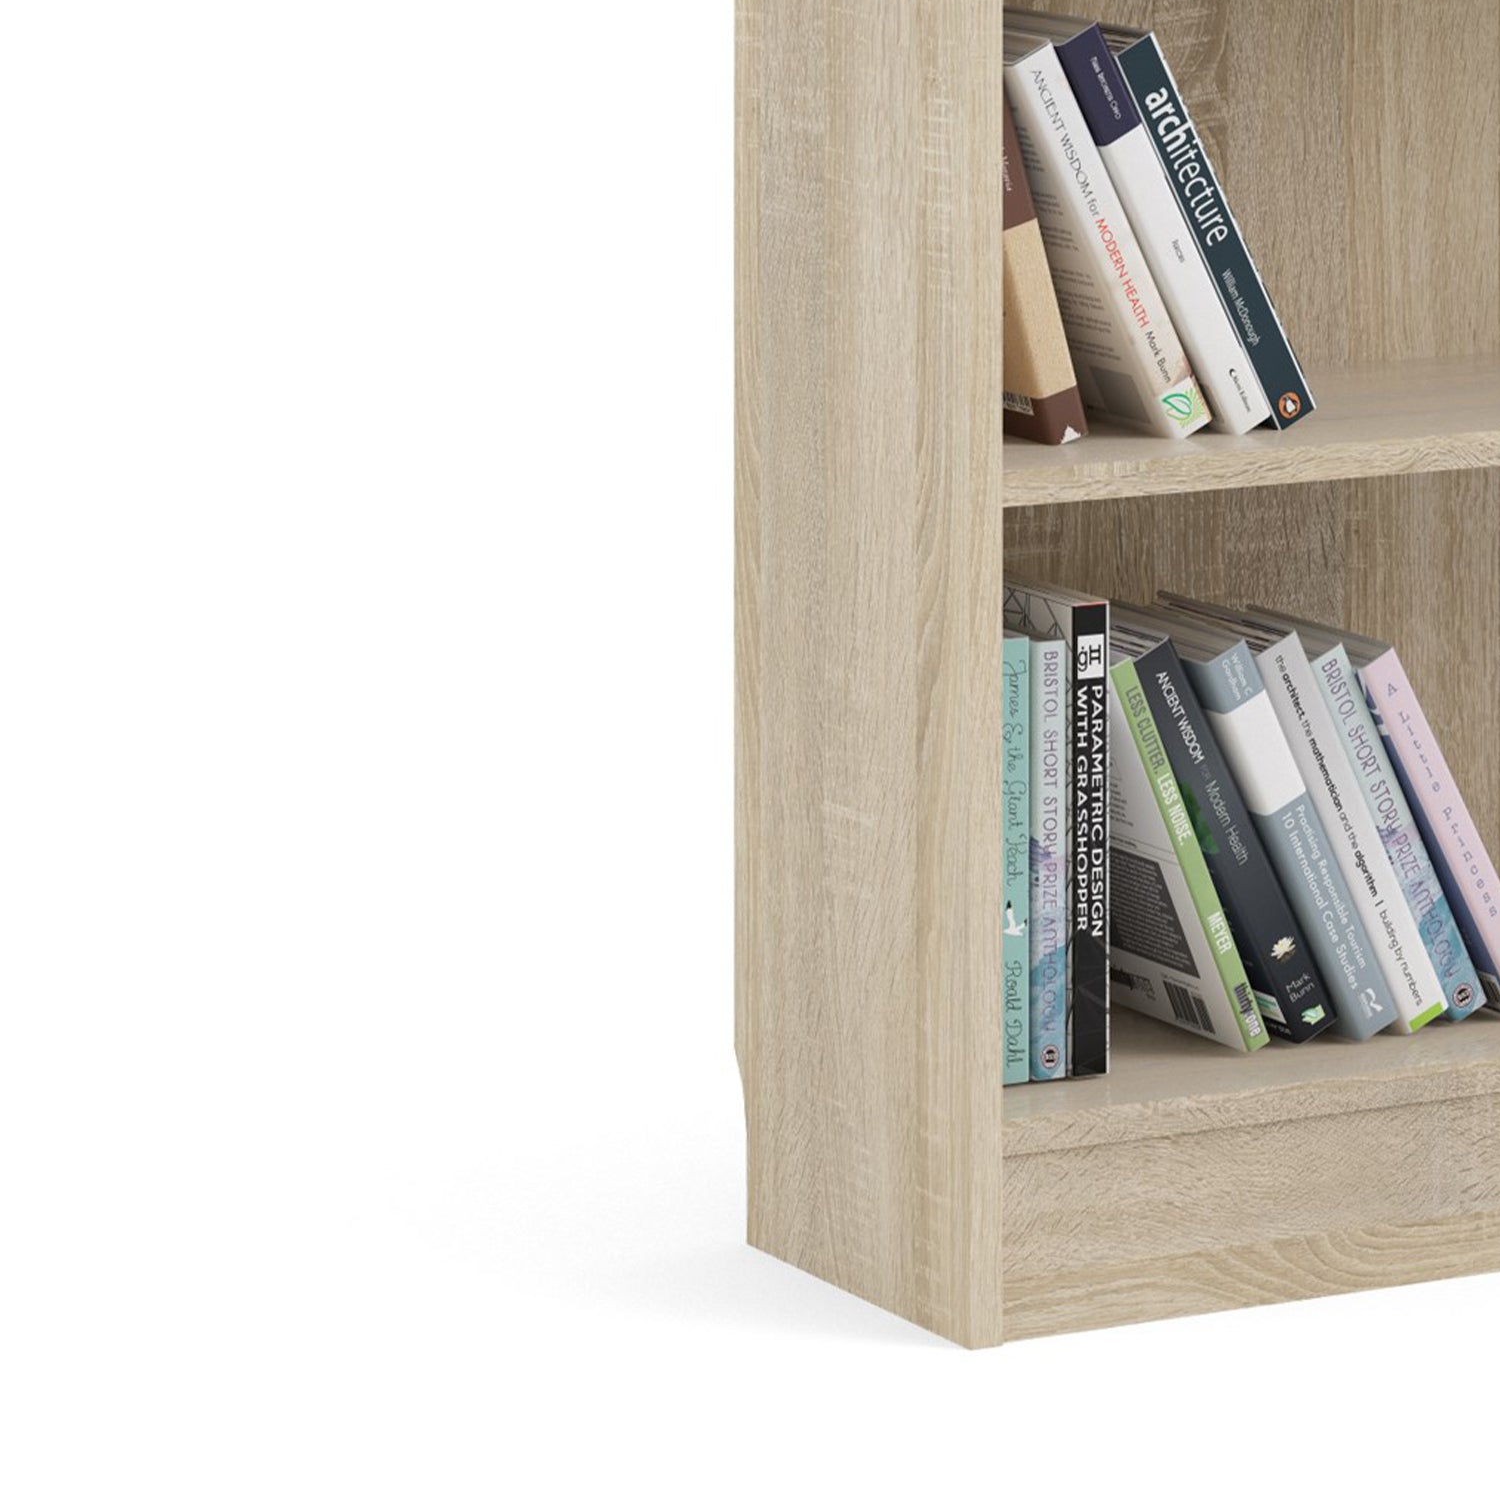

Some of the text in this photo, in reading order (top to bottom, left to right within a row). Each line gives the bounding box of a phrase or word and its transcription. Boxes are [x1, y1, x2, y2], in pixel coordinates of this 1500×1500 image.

[1145, 87, 1228, 247] architecture
[1031, 69, 1067, 132] ANCIENT
[1060, 132, 1093, 198] WISDOM
[1087, 196, 1100, 217] for
[1095, 218, 1129, 278] MODERN
[1122, 277, 1151, 328] HEALTH
[1145, 331, 1160, 358] Mark
[1157, 357, 1172, 384] Bunn
[1221, 267, 1239, 300] William
[1234, 297, 1260, 347] McDonough
[1004, 659, 1027, 717] James
[1044, 651, 1059, 723] BRISTOL
[1387, 683, 1398, 697] A
[1007, 747, 1024, 773] the
[1043, 730, 1059, 788] SHORT
[1125, 686, 1191, 846] LESS CLUTTER. LESS NOISE.
[1155, 671, 1186, 721] ANCIENT
[1177, 715, 1205, 765] WISDOM
[1205, 780, 1233, 828] Modern
[1225, 823, 1249, 866] Health
[1321, 658, 1357, 726] BRISTOL
[1348, 724, 1382, 778] SHORT
[1370, 780, 1402, 835] STORY
[1392, 832, 1421, 879] PRIZE
[1003, 780, 1027, 830] Giant
[1043, 798, 1058, 859] STORY
[1077, 686, 1089, 930] WITH GRASSHOPPER
[1091, 684, 1104, 937] PARAMETRIC DESIGN
[1275, 655, 1423, 1007] the architect, the mathematician and the algorithm building by numbers
[1042, 863, 1058, 909] PRIZE
[1281, 812, 1358, 990] 10 International Case Studies
[1318, 859, 1347, 924] Responsible
[1345, 922, 1366, 970] Tourism
[1207, 911, 1233, 954] MEYER
[1005, 960, 1024, 1068] Roald Dahl
[1286, 973, 1311, 993] Mark
[1290, 982, 1315, 1004] Bunn
